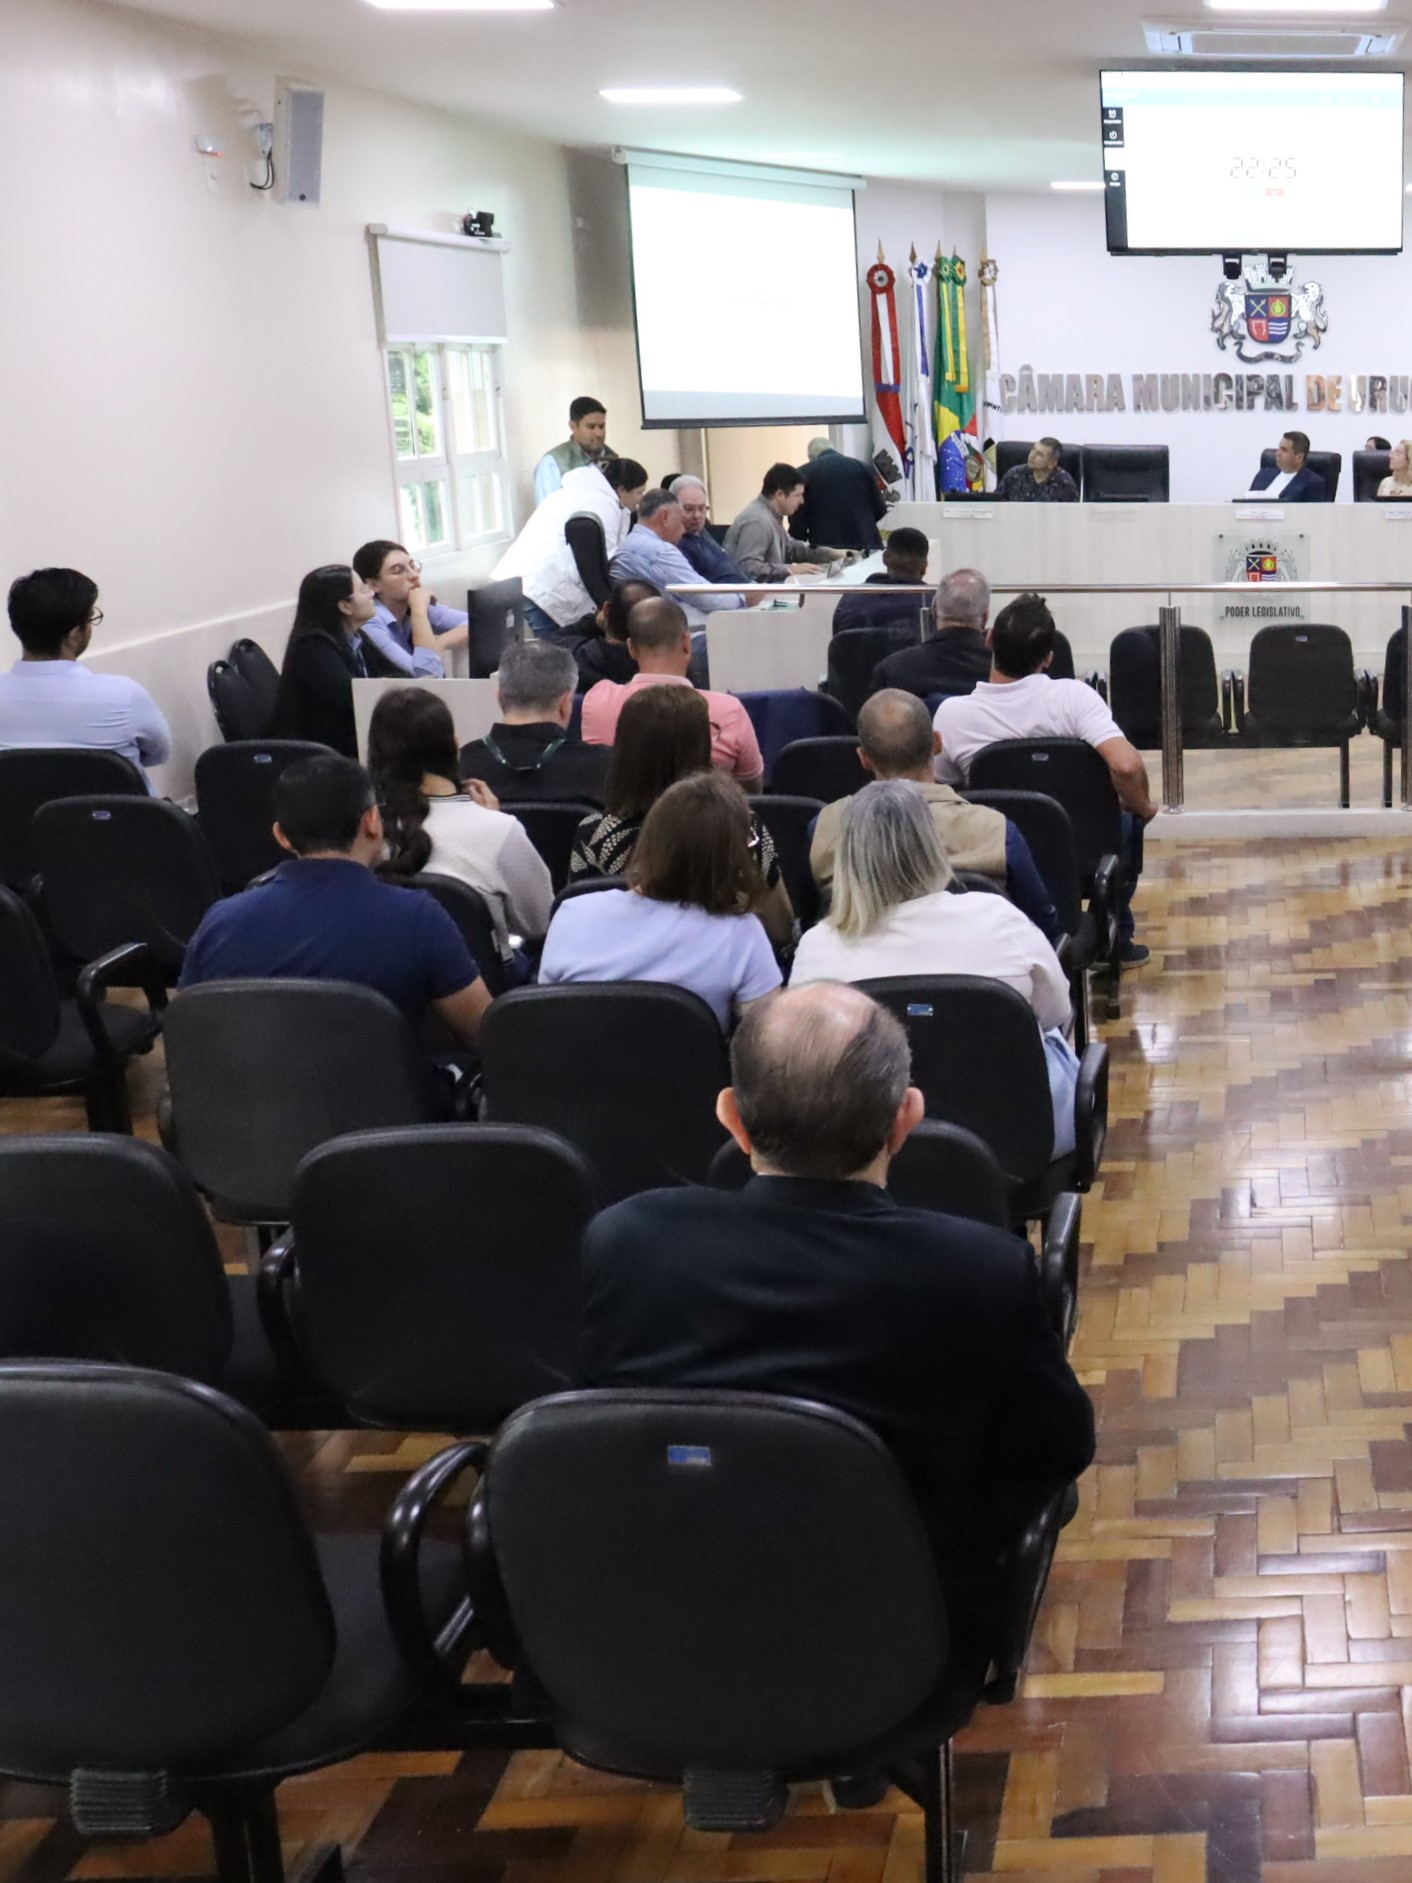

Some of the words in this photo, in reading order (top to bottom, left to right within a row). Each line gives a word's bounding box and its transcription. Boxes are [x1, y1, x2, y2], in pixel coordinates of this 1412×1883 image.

[1230, 157, 1297, 179] 22:25
[999, 364, 1126, 413] CÂMARA
[1132, 372, 1298, 413] MUNICIPAL
[1306, 374, 1342, 413] DE
[1225, 606, 1250, 617] PODER
